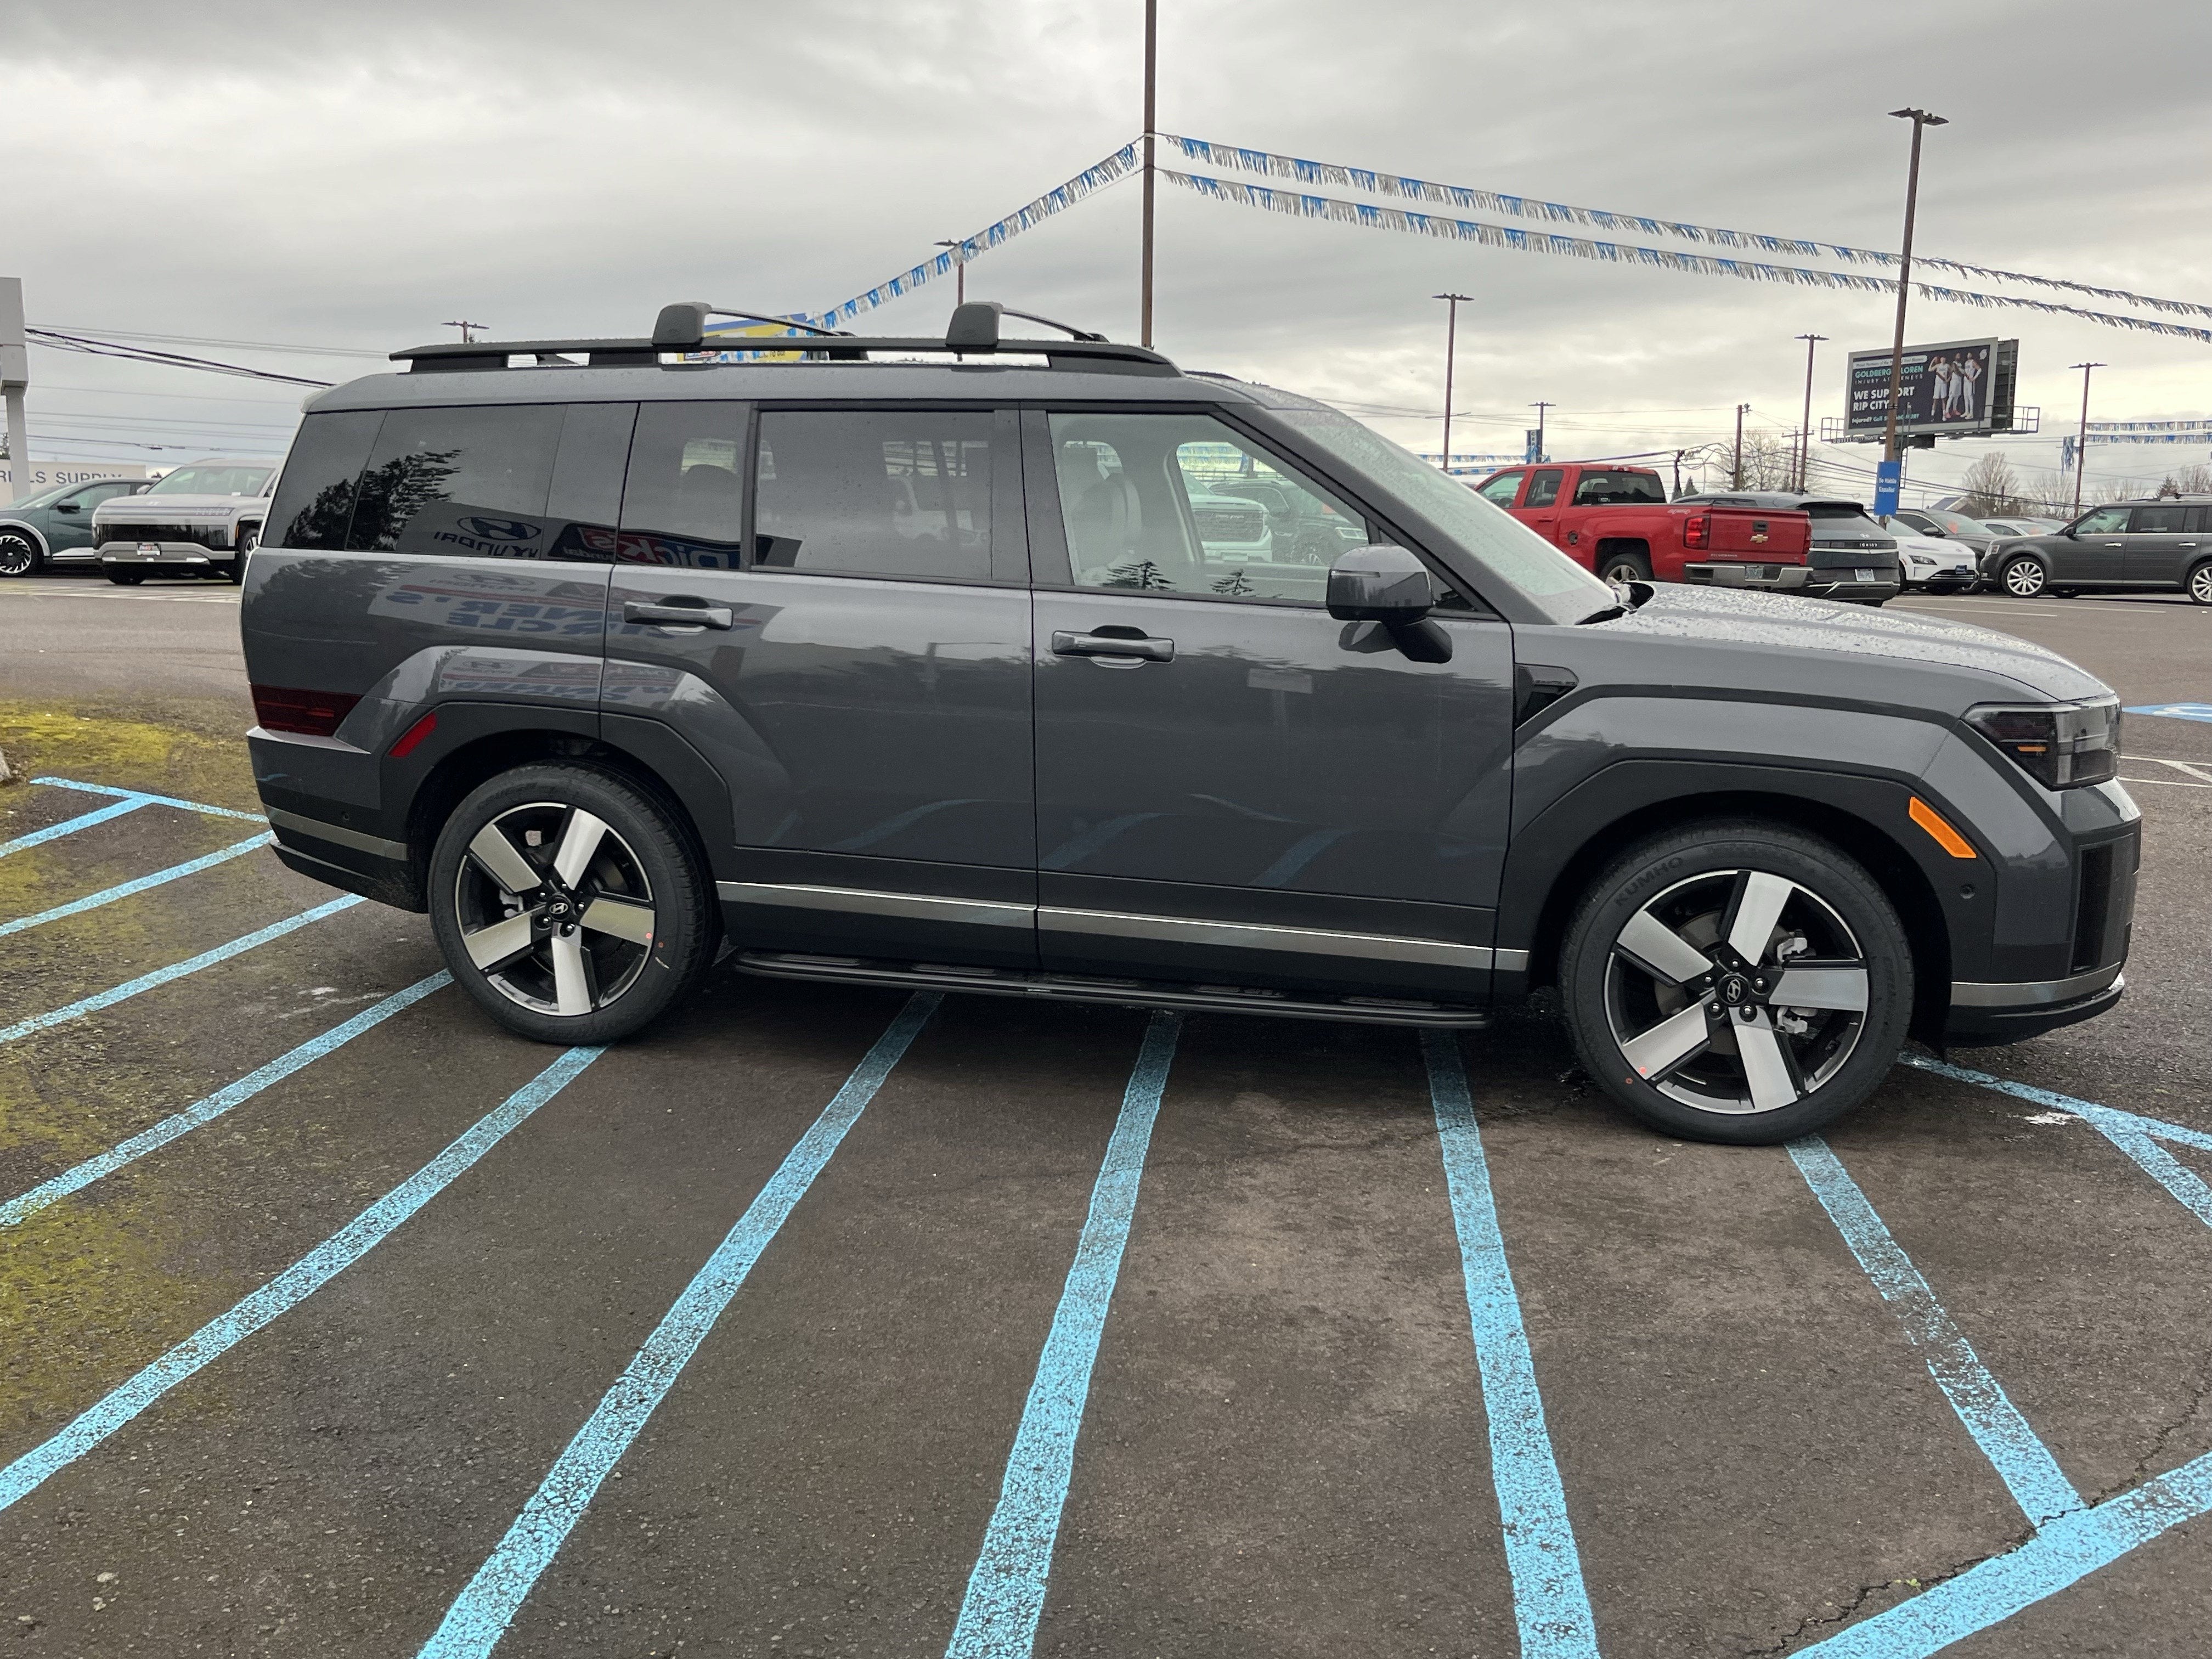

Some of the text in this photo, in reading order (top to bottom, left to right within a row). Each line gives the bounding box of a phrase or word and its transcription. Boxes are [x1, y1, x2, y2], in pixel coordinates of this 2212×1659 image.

[1855, 365, 1923, 378] GOLDBERG LOREN
[1854, 386, 1915, 400] WE SUPORT
[1853, 399, 1889, 411] RIP CITY
[1615, 857, 1683, 906] KUMHO
